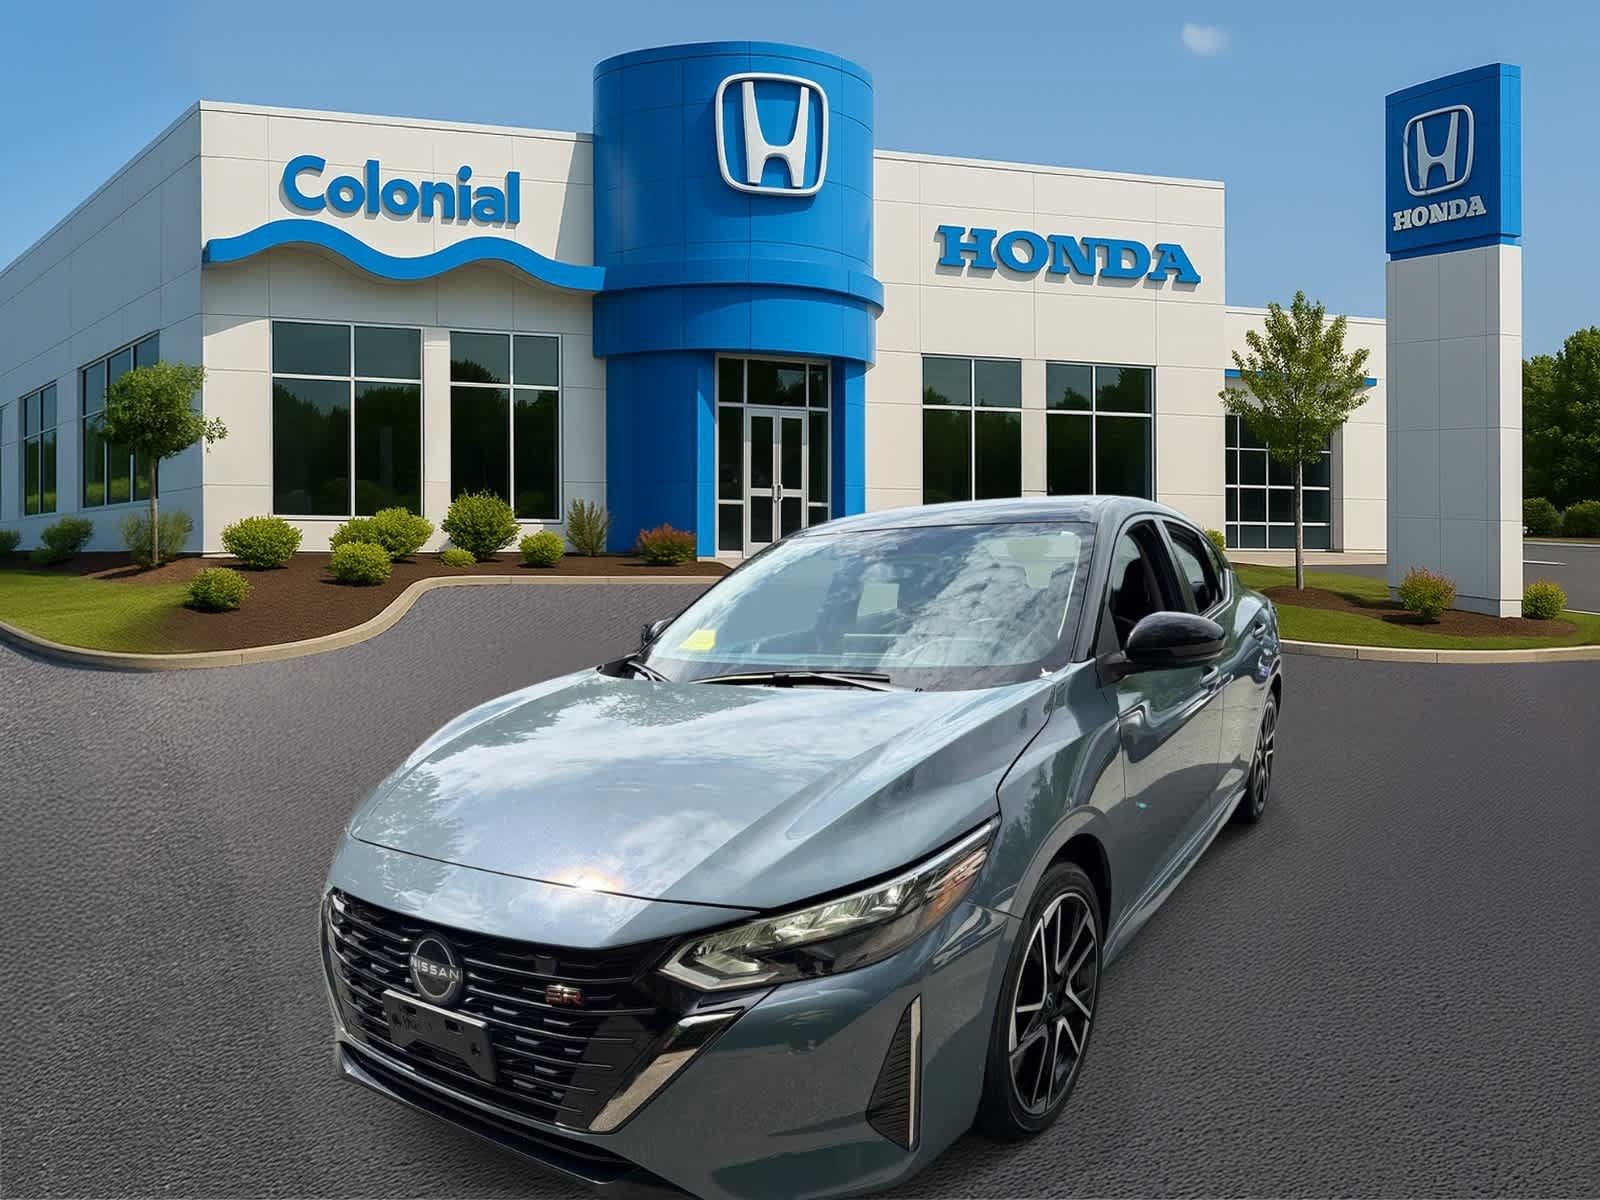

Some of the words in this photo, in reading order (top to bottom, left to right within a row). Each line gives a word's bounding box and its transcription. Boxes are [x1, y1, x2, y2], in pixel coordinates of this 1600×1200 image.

[282, 154, 521, 226] Colonial
[1393, 195, 1487, 231] HONDA
[936, 224, 1202, 286] HONDA
[410, 955, 460, 981] NISSAN
